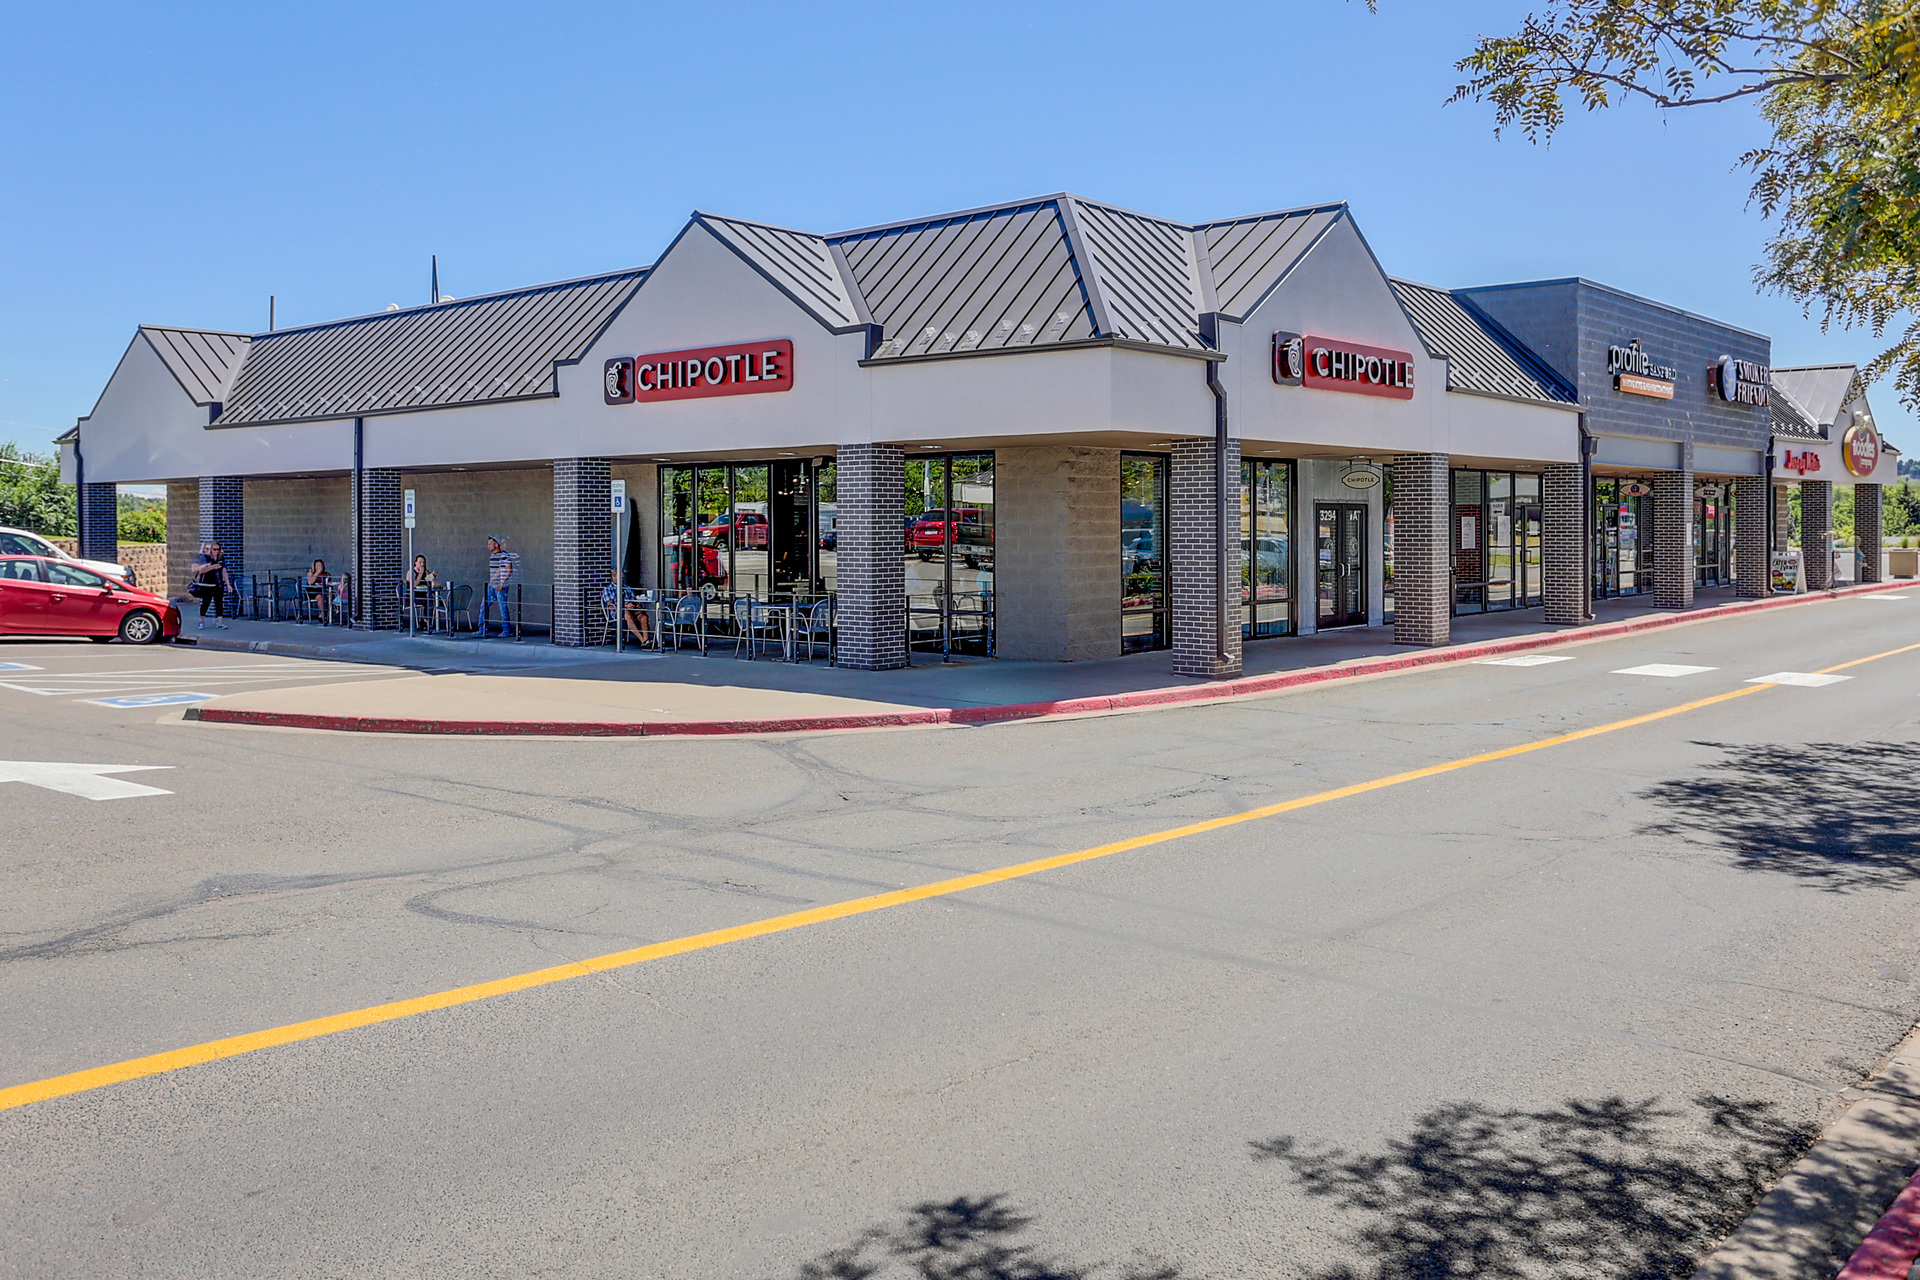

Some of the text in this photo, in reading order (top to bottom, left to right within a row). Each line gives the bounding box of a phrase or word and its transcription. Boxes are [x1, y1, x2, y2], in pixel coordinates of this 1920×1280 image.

[637, 351, 781, 391] CHIPOTLE
[1314, 347, 1415, 389] CHIPOTLE
[1609, 338, 1649, 375] profile
[1738, 360, 1769, 385] SMOKER
[1737, 382, 1770, 407] FRIENDLY
[1320, 510, 1336, 521] 3294
